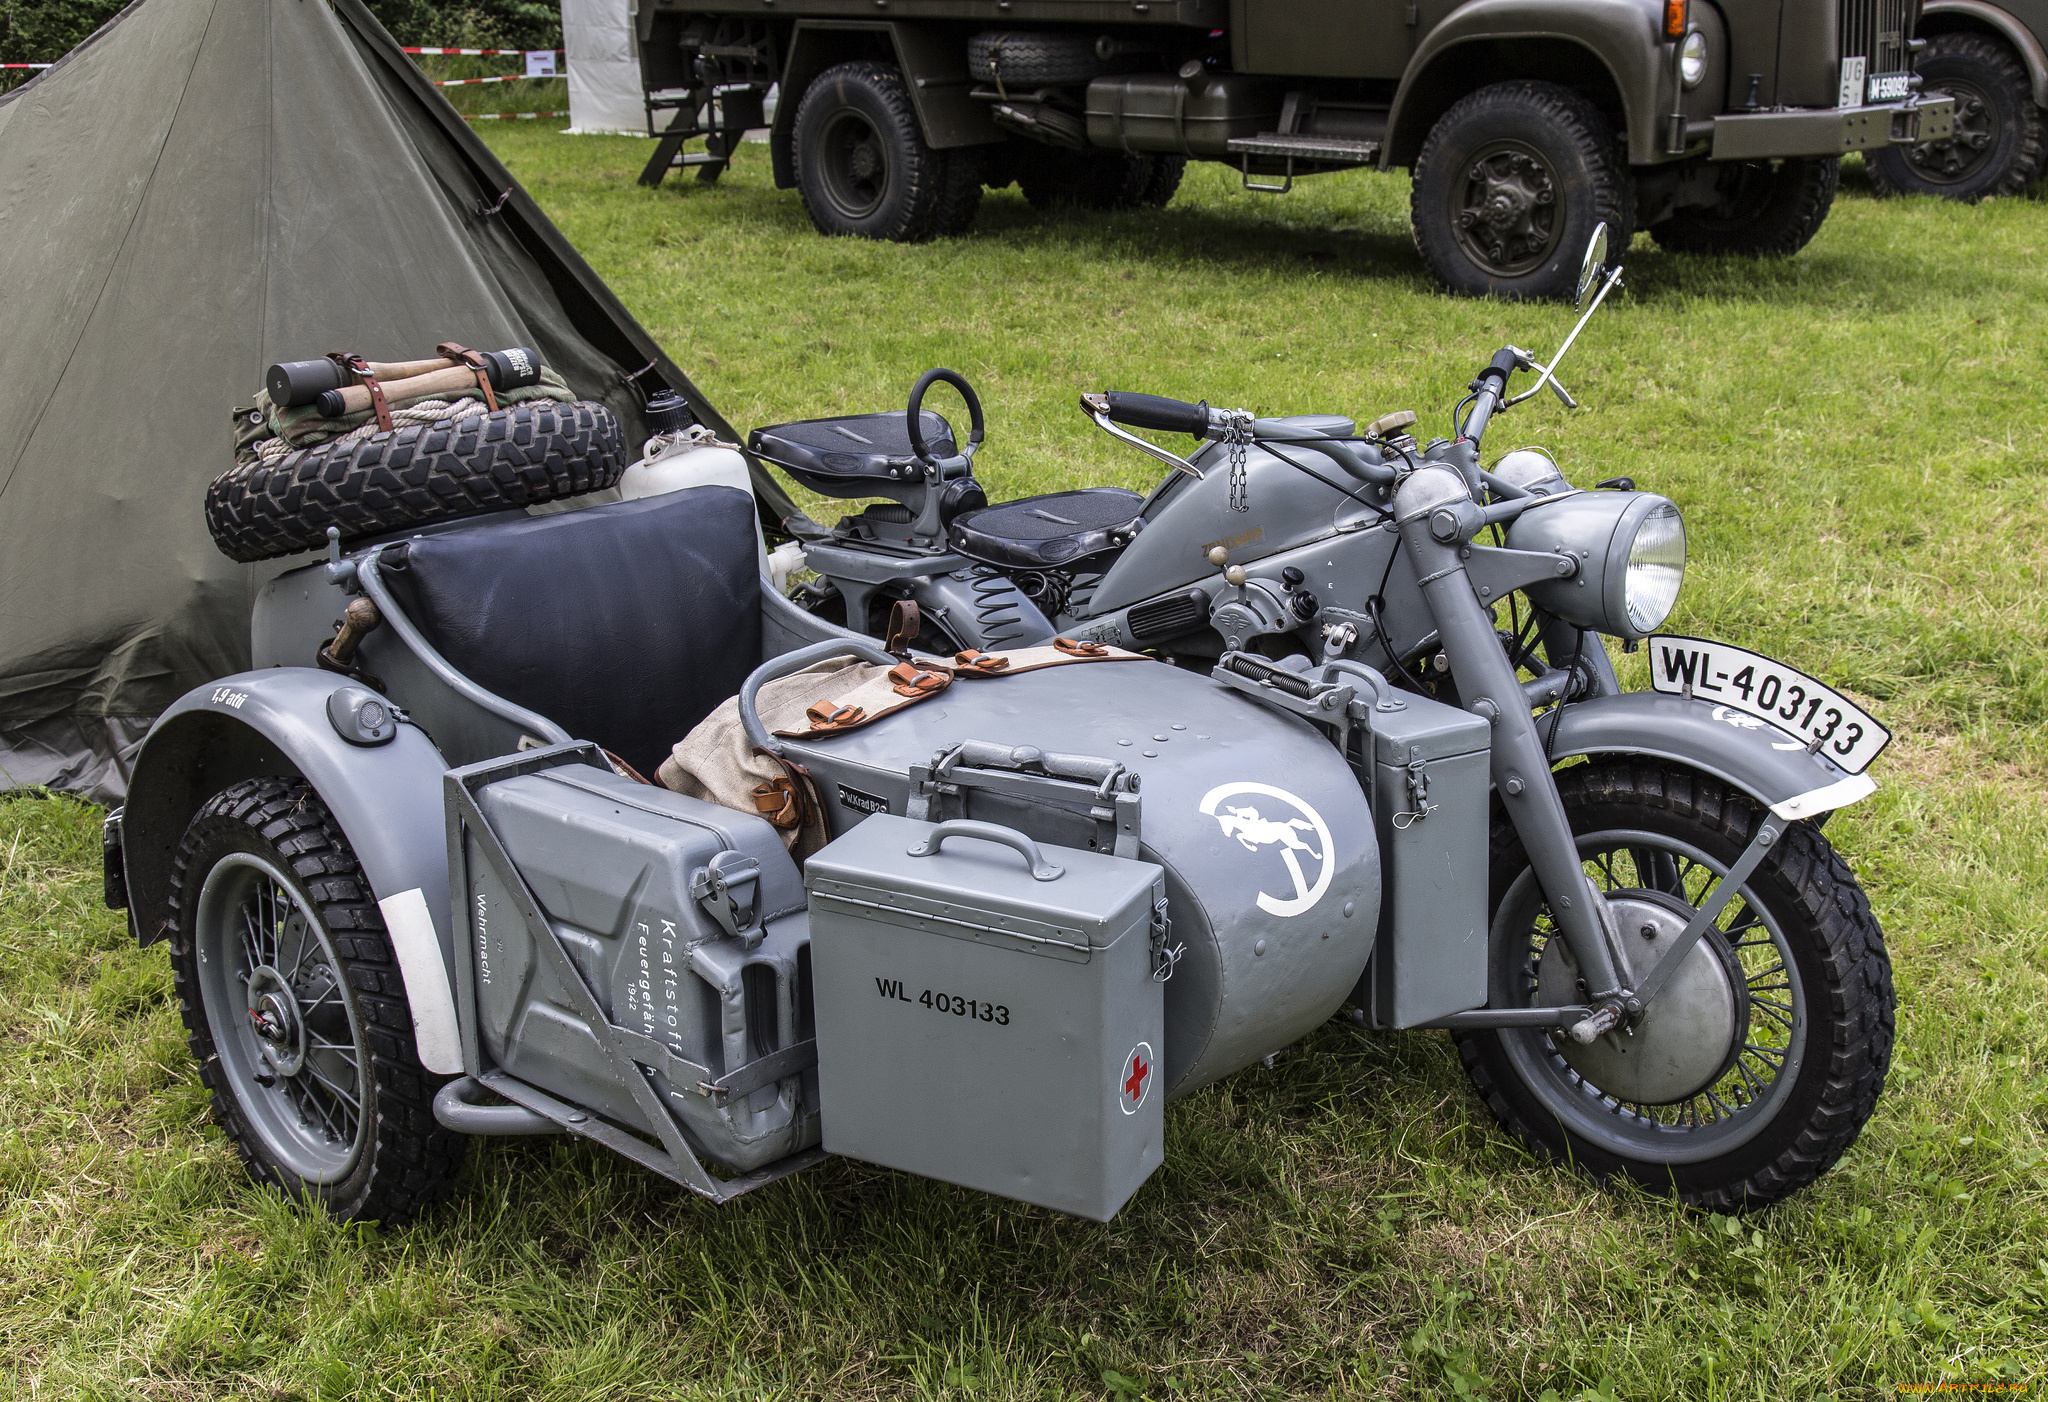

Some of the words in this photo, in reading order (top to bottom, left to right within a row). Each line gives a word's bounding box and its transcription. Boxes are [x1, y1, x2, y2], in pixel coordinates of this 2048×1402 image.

[1843, 61, 1862, 81] UG
[211, 686, 231, 705] 1,9
[1661, 645, 1864, 756] WL-403133
[476, 893, 491, 984] Wehrmacht
[627, 982, 638, 1011] 1942
[660, 918, 683, 1052] Kraftstoff
[874, 976, 912, 1003] WL
[918, 989, 1010, 1026] 403133
